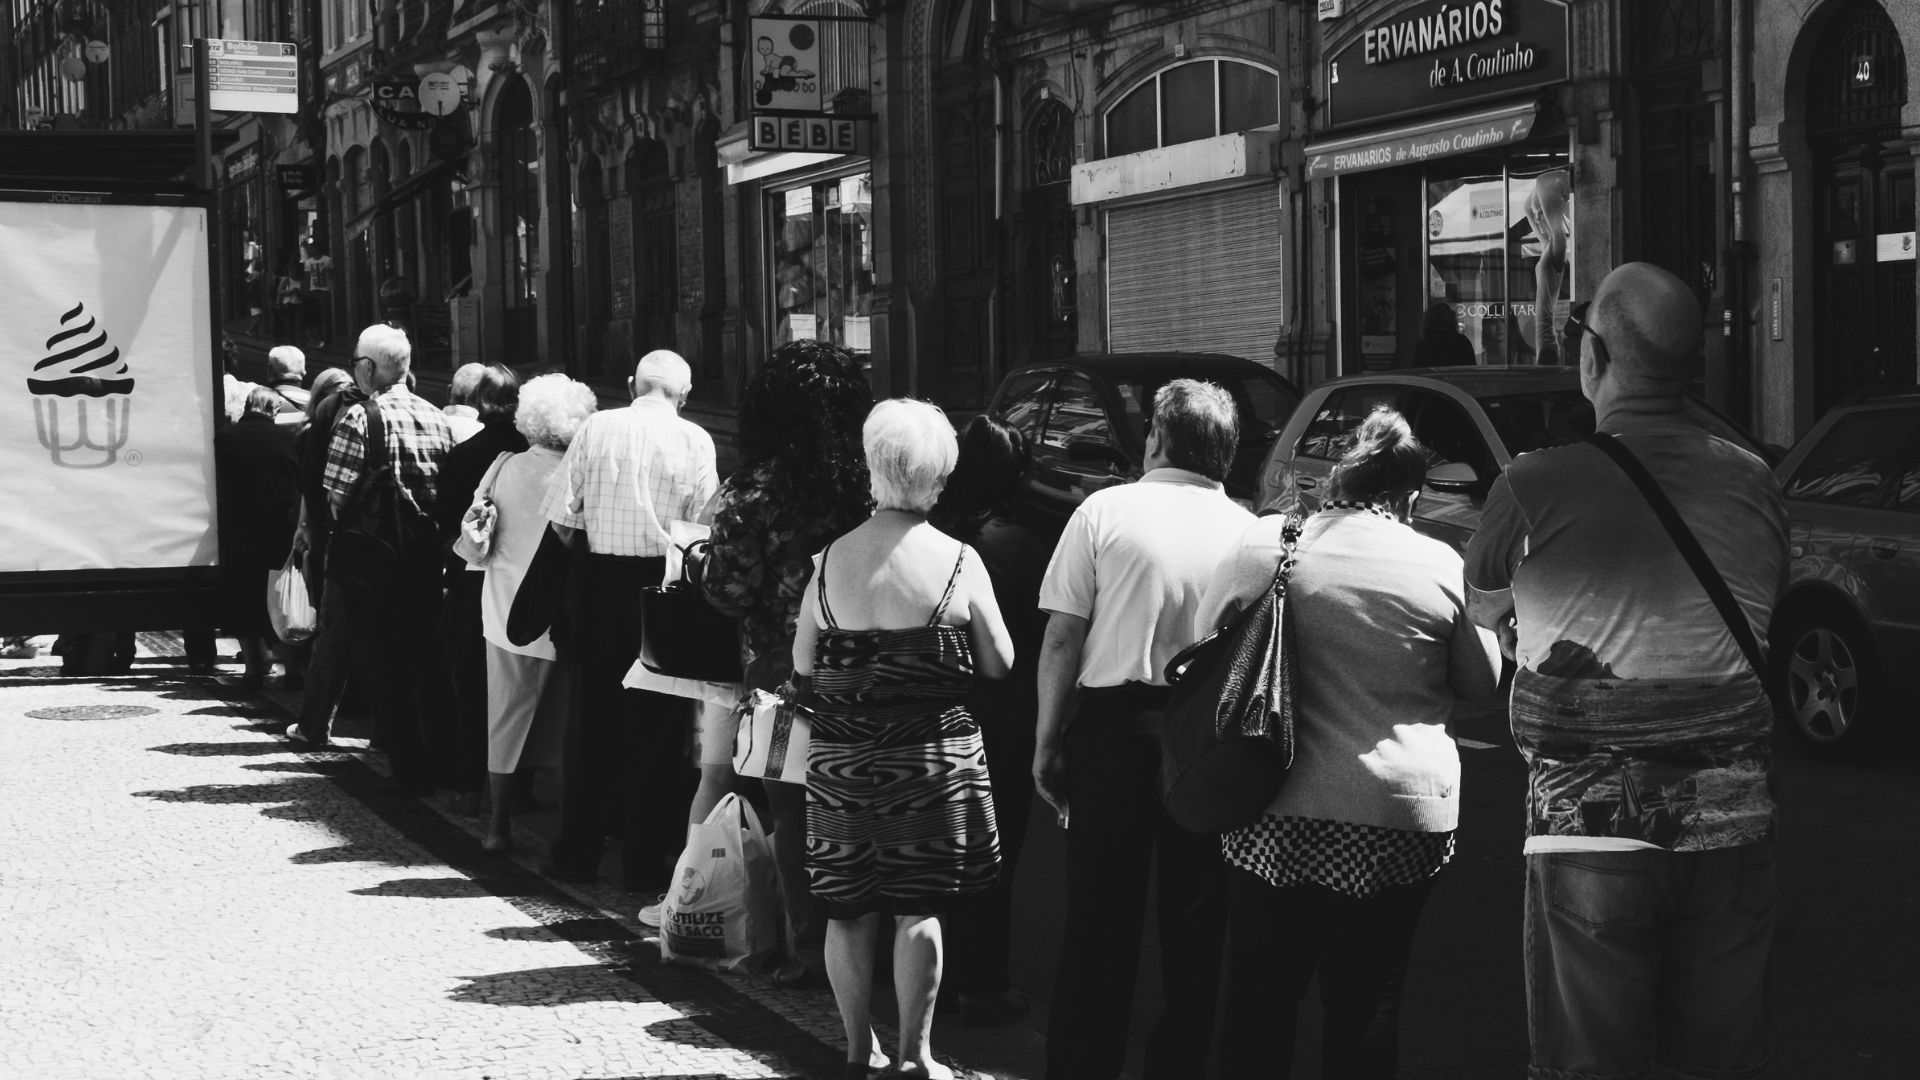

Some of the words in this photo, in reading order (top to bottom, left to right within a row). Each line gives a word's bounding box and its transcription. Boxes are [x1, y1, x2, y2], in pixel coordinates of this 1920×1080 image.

[1364, 0, 1502, 65] ERVANÁRIOS
[1430, 59, 1446, 88] de
[1450, 58, 1463, 83] A.
[1467, 42, 1533, 80] Coutinho
[1856, 61, 1870, 82] 40
[378, 86, 415, 98] CA
[1334, 147, 1392, 171] ERVANARIOS
[1395, 149, 1407, 161] de
[1408, 138, 1450, 161] Augusto
[1453, 127, 1504, 151] Coutinho
[49, 193, 102, 204] JCDecaux
[1467, 304, 1536, 317] COLLITAR
